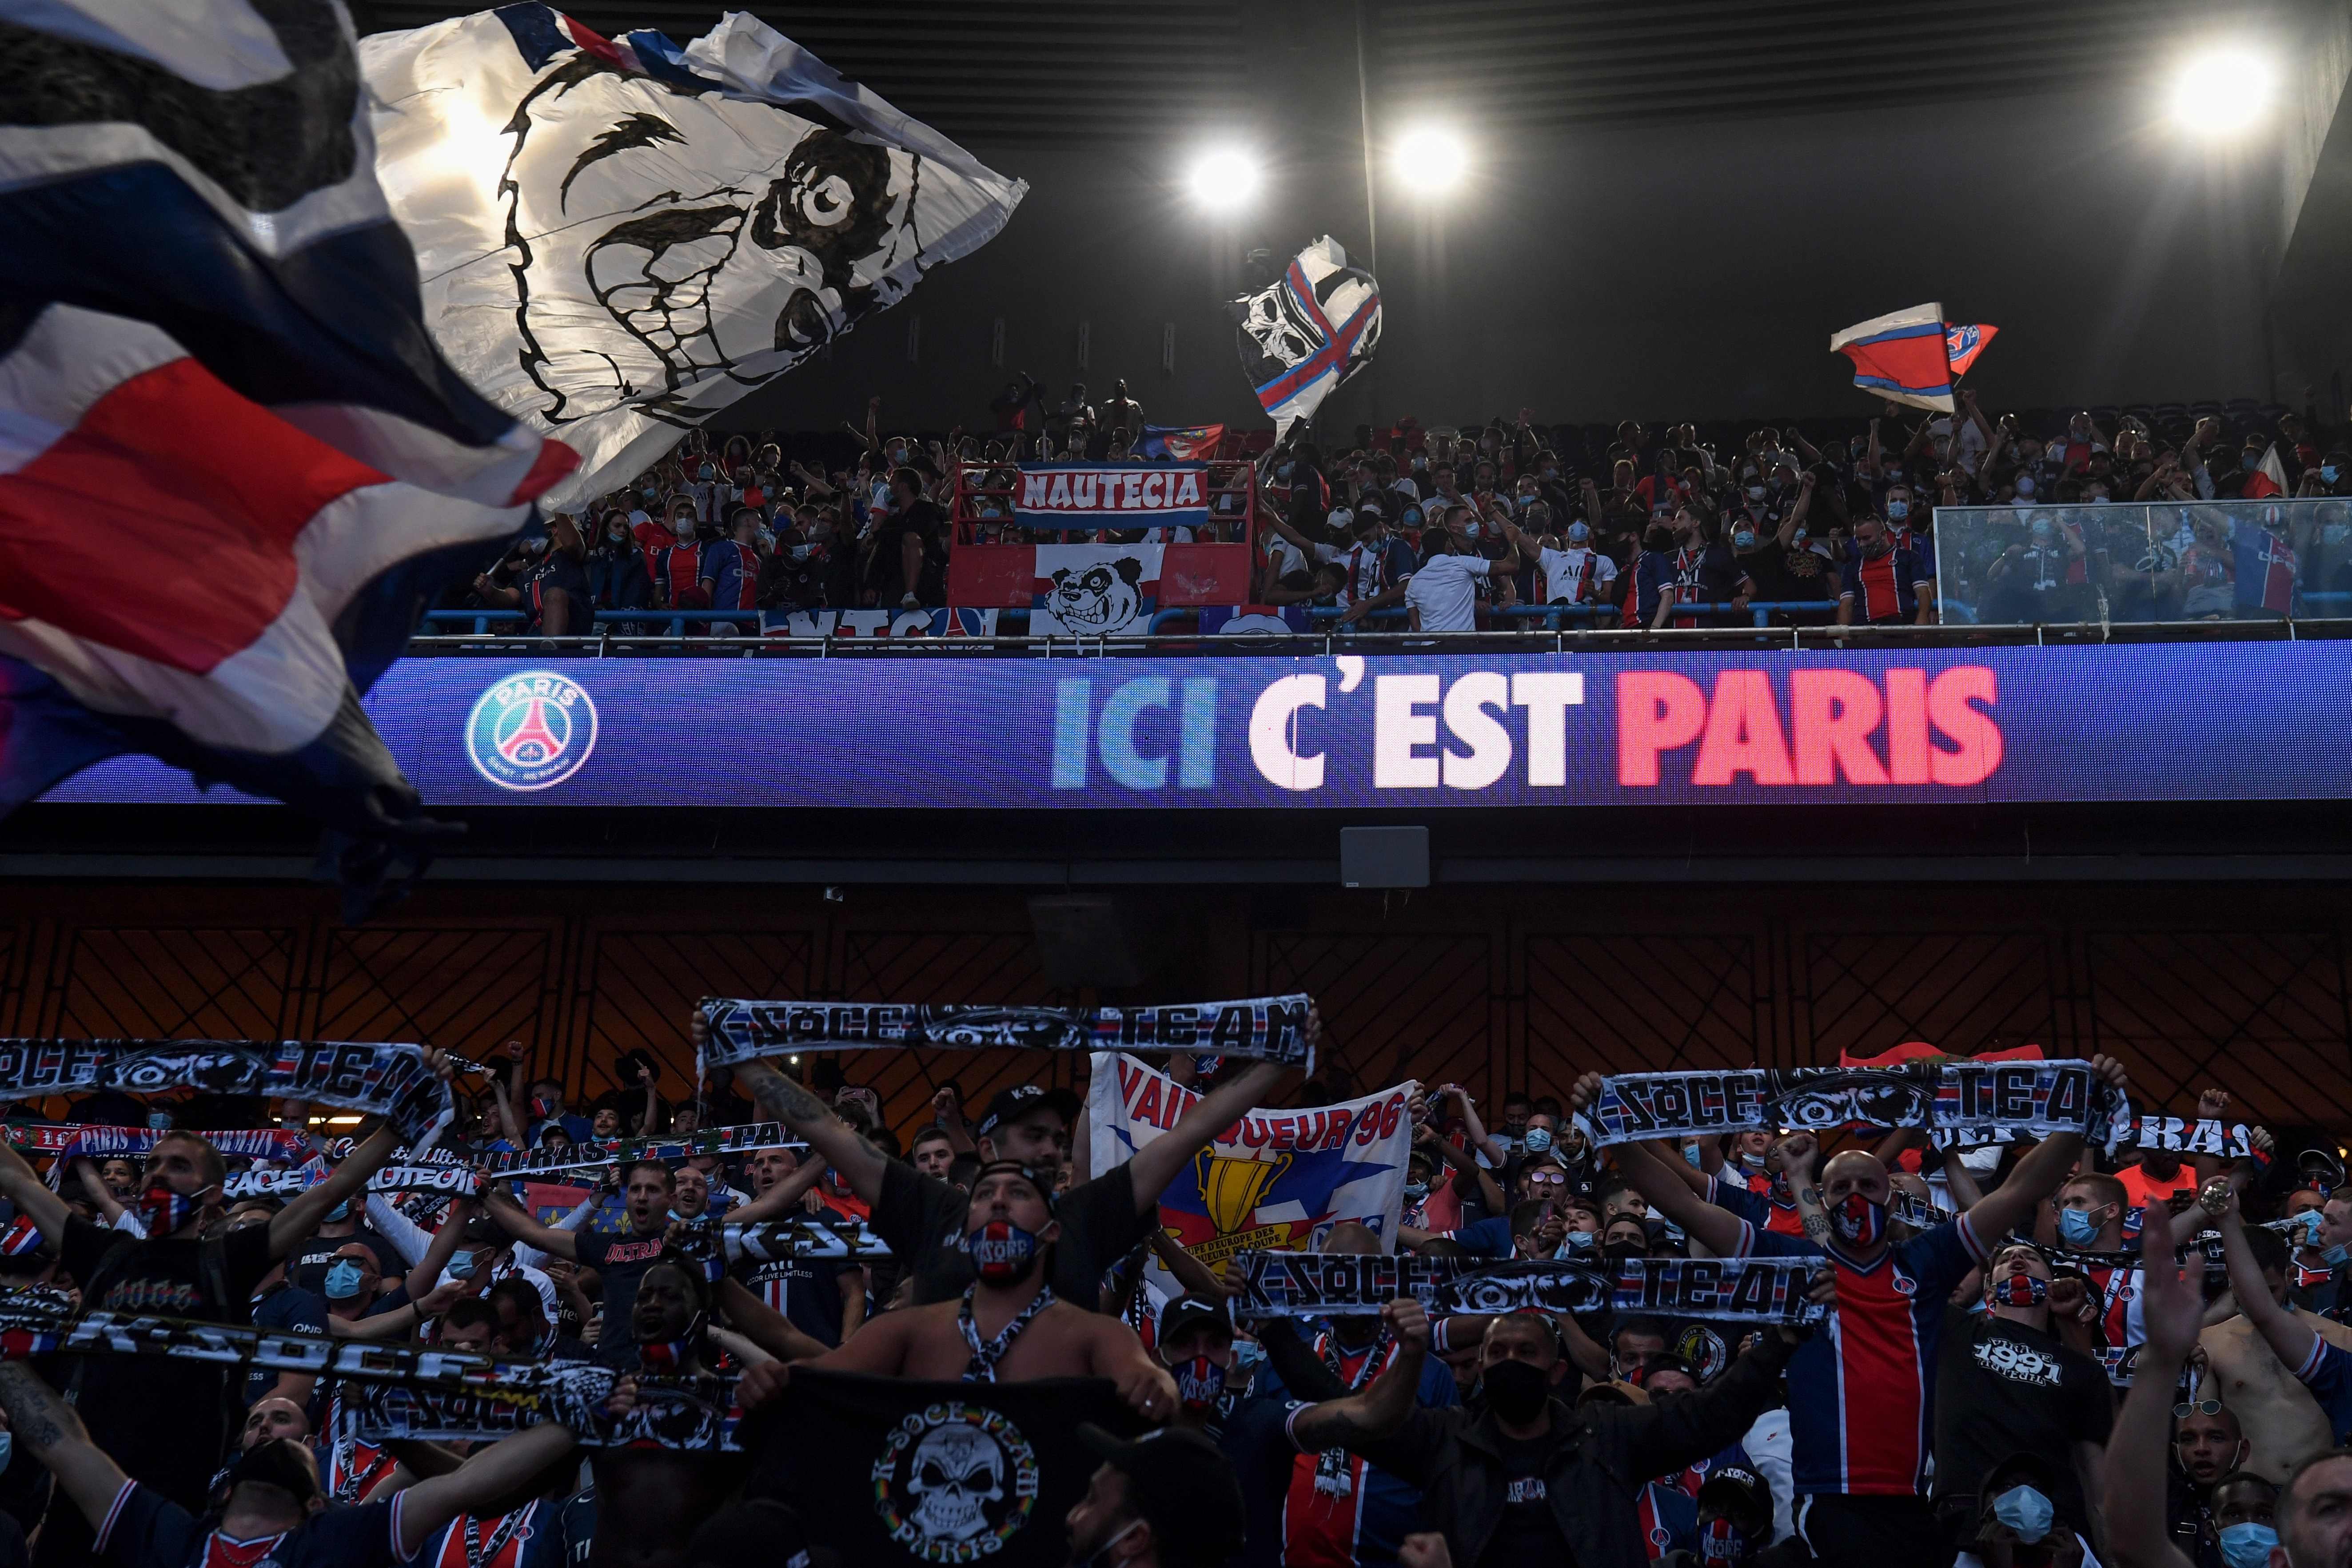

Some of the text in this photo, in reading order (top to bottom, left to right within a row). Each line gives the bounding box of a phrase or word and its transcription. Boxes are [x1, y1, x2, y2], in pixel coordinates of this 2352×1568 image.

[1022, 473, 1200, 509] NAUTECIA
[495, 676, 579, 706] PARIS
[1052, 655, 2005, 791] ICI C'EST PARIS
[1116, 1000, 1308, 1055] TEAM
[80, 1128, 129, 1153] PARIS
[1247, 1234, 1282, 1250] COUPE
[1255, 1226, 1275, 1238] DES
[604, 1237, 669, 1265] ULTRA
[764, 1271, 779, 1281] LIVE
[780, 1268, 813, 1279] LIMITLESS
[1973, 1342, 2061, 1385] 1991
[980, 1405, 1040, 1500] TEAM
